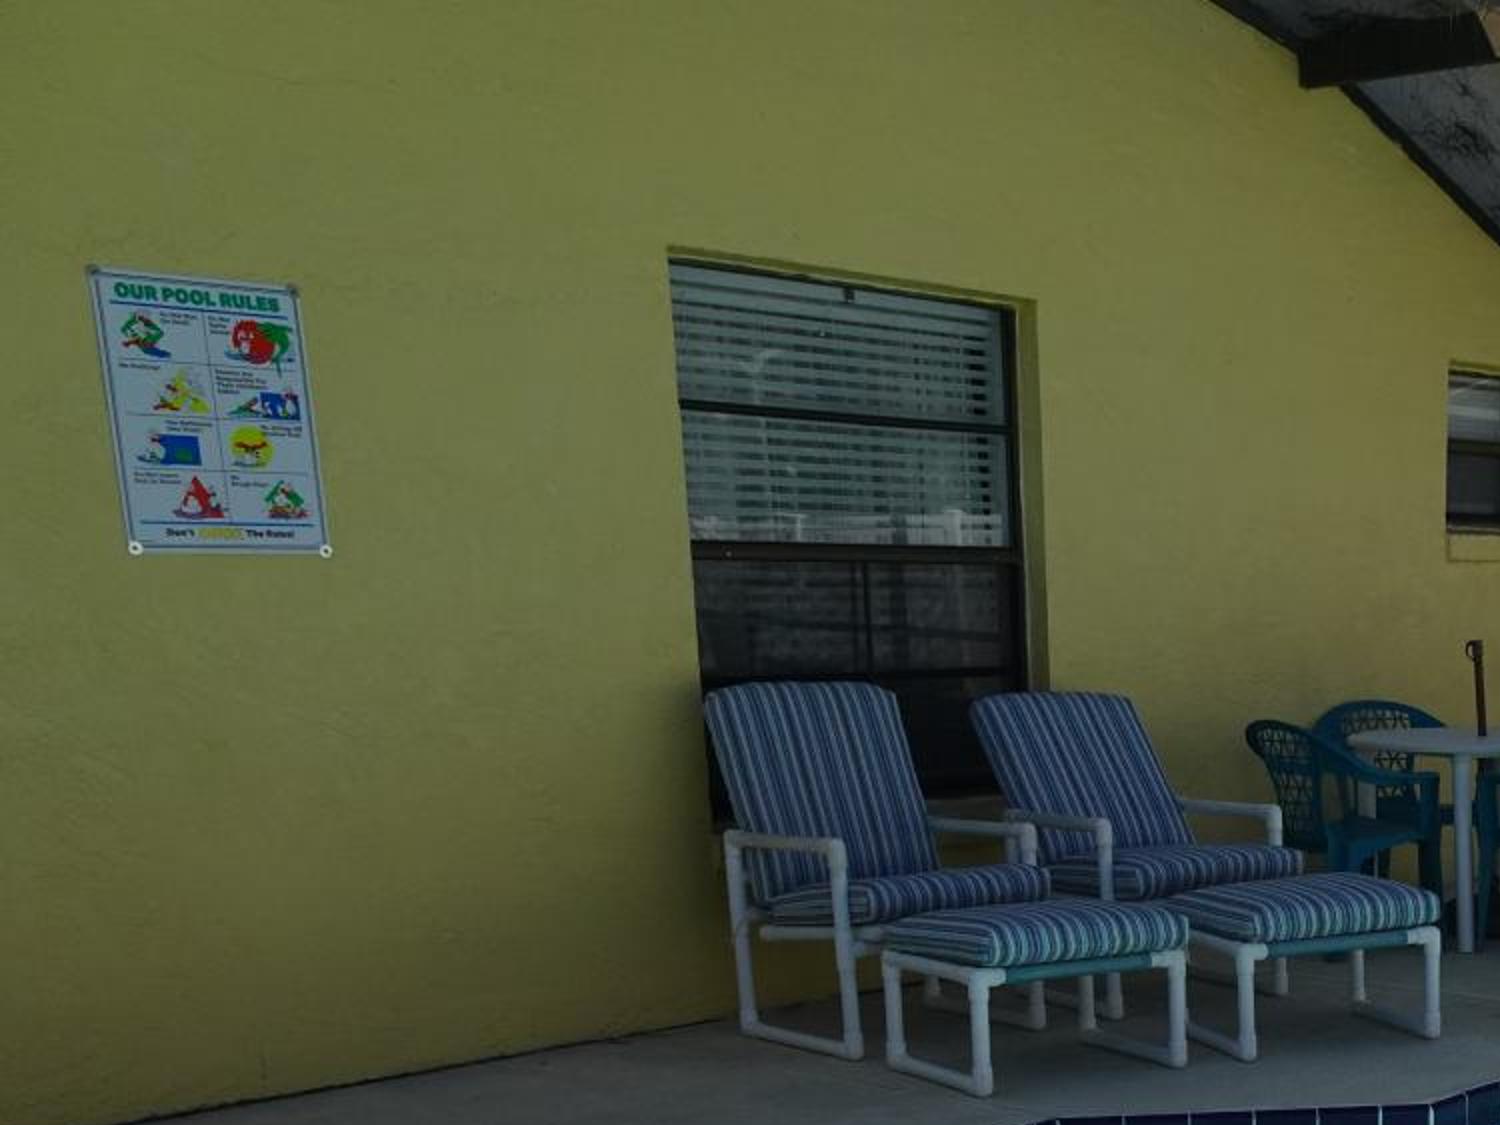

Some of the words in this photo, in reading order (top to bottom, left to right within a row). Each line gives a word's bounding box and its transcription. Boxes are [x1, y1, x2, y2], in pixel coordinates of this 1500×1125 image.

[114, 282, 158, 301] OUR
[162, 287, 216, 307] POOL
[220, 294, 280, 313] RULES
